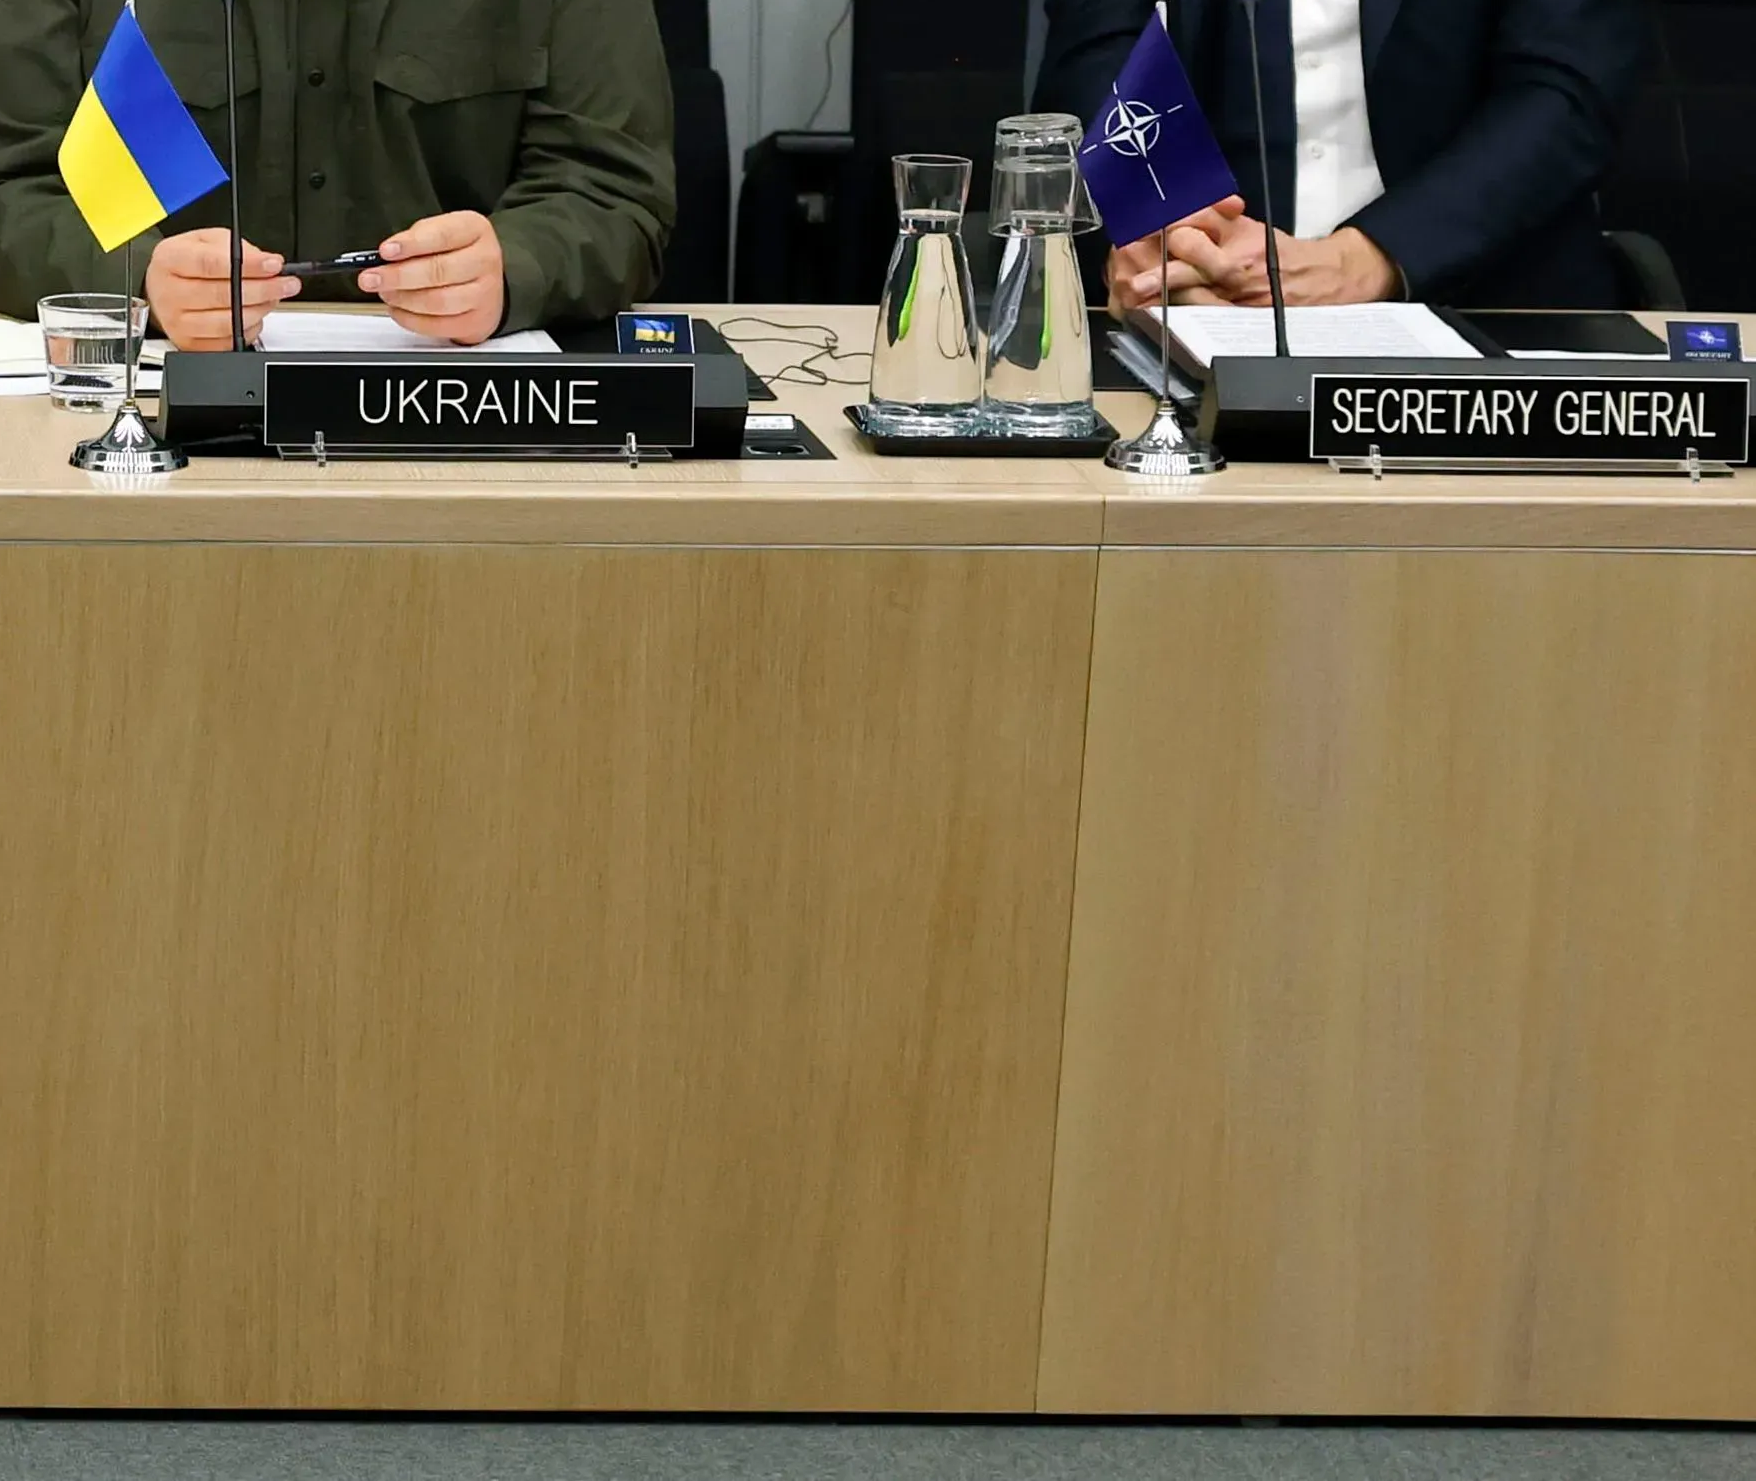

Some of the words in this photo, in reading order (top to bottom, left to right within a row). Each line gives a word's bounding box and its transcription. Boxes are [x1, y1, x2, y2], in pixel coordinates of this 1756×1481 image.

[359, 378, 599, 425] UKRAINE
[1331, 387, 1539, 436] SECRETARY
[1555, 390, 1717, 438] GENERAL
